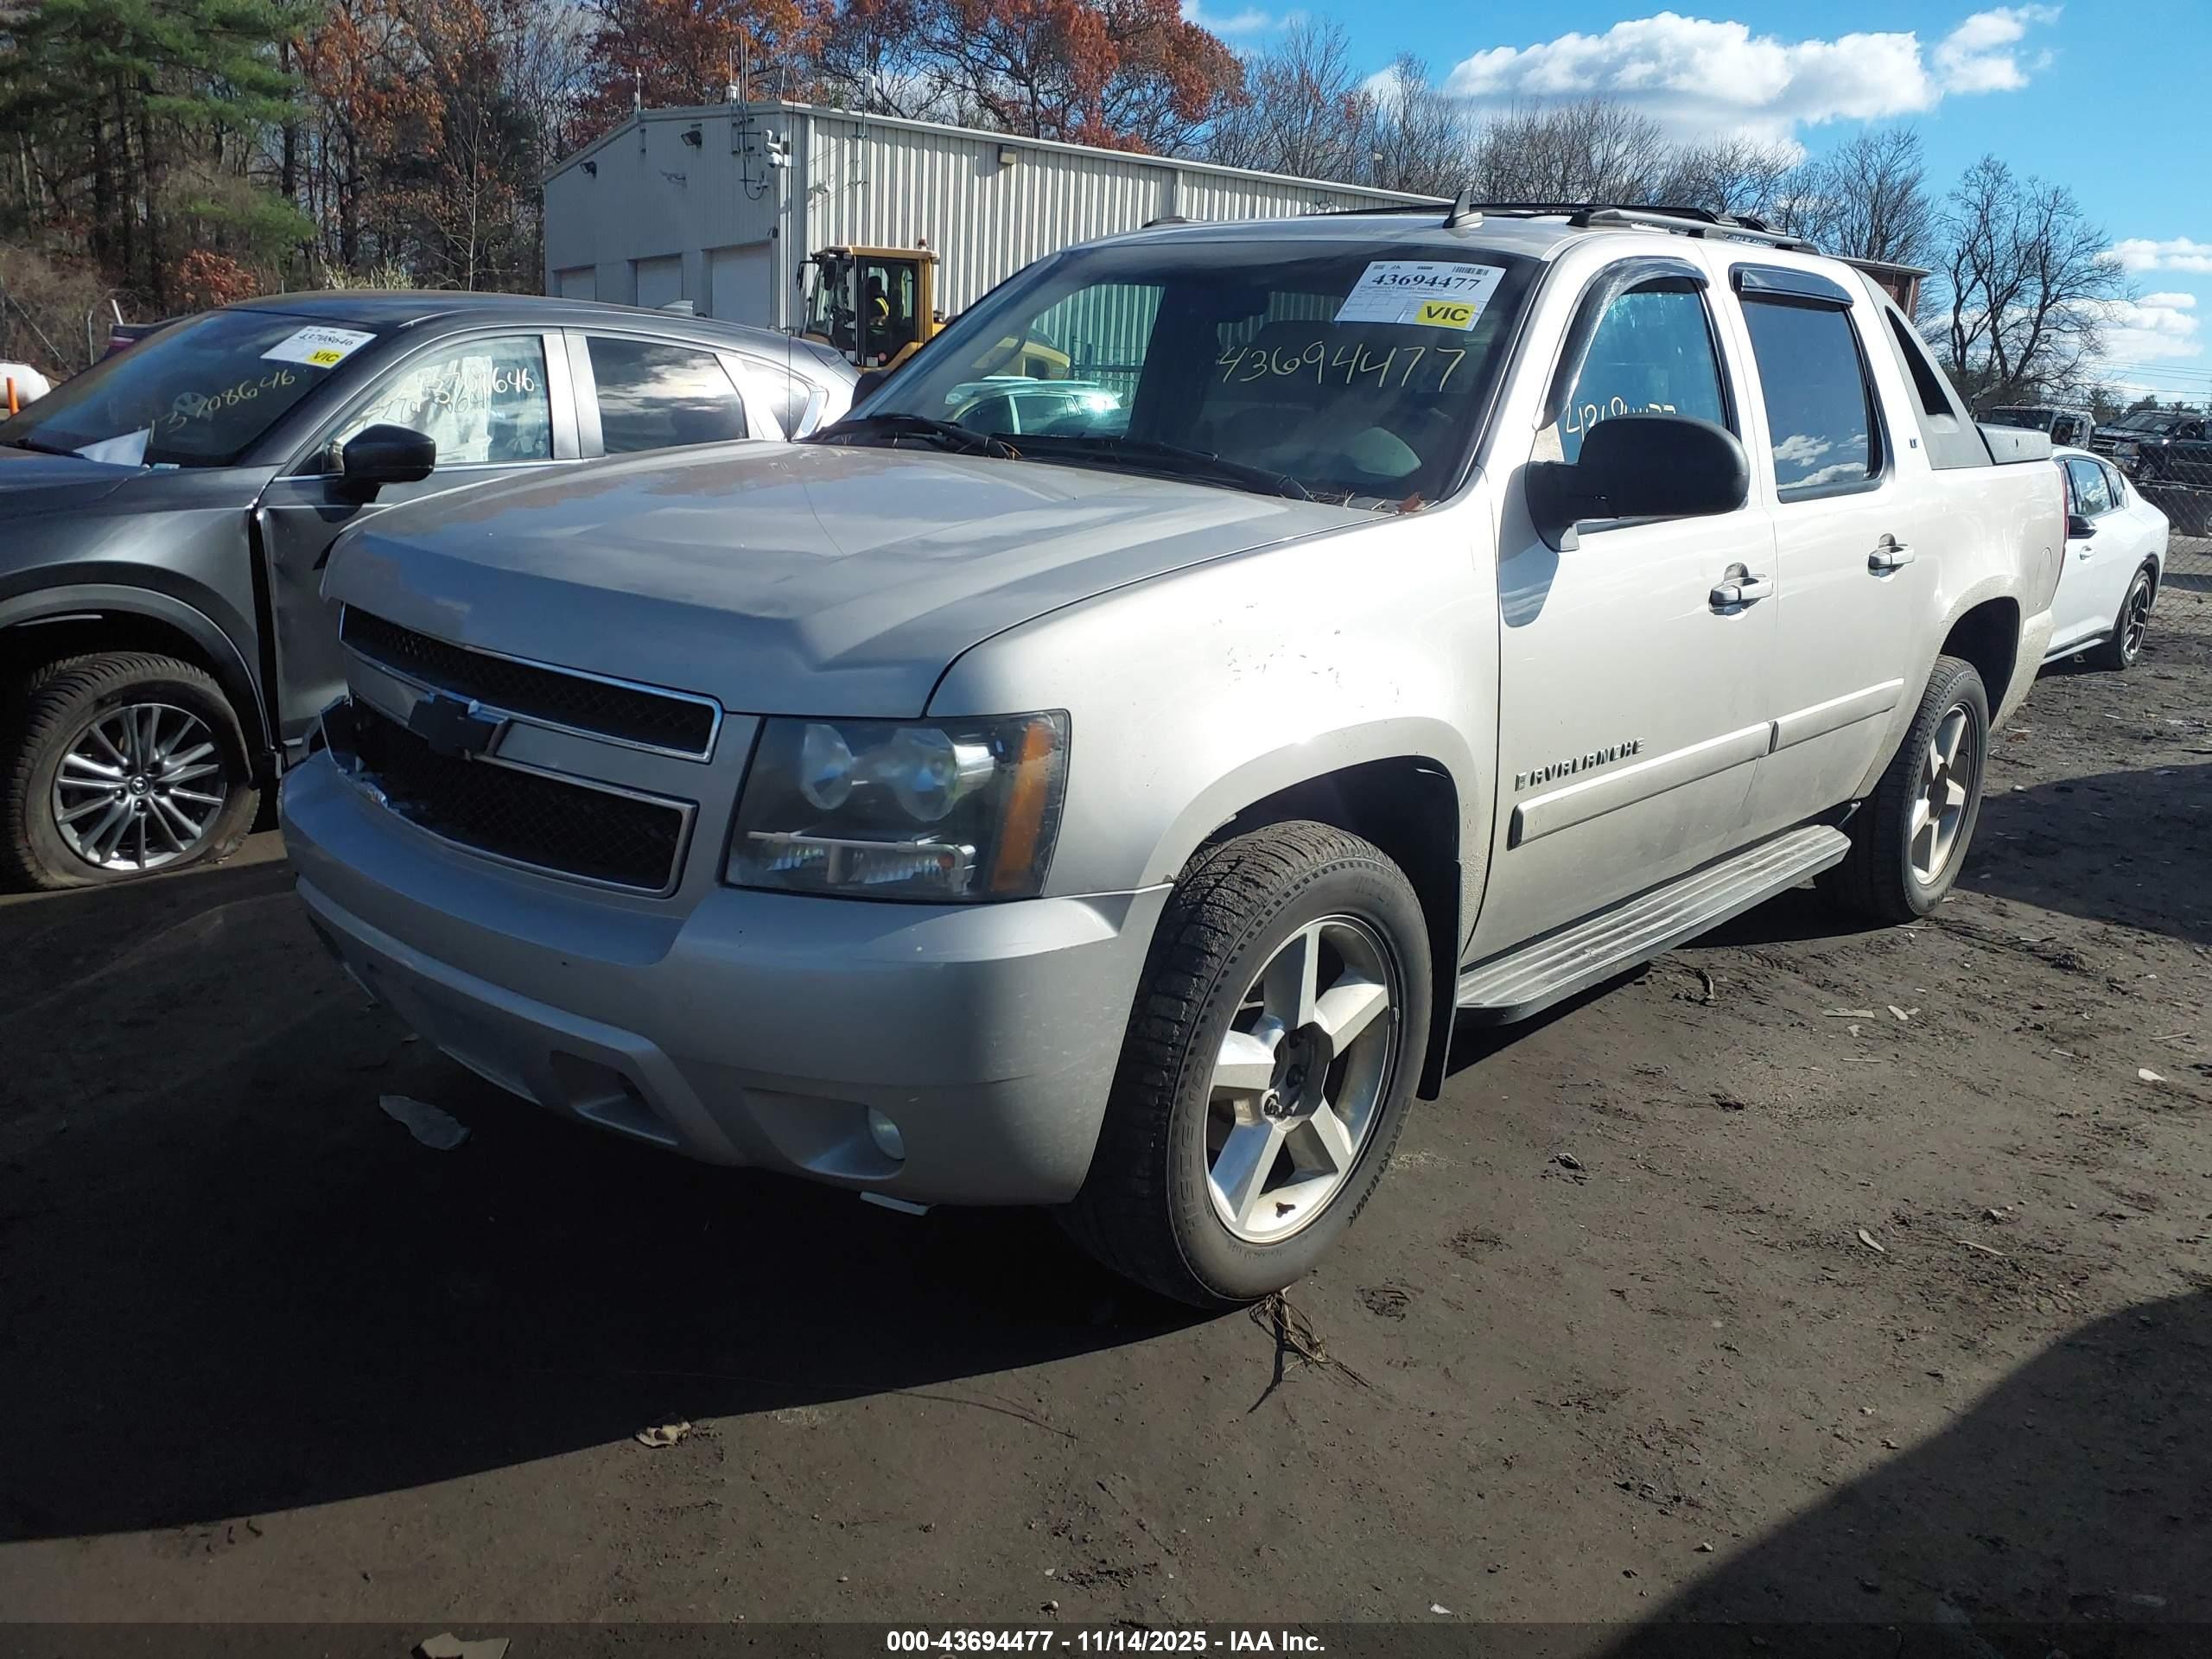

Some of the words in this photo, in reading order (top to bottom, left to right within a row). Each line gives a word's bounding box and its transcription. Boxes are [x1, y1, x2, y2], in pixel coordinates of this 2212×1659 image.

[1371, 273, 1481, 291] 43694477
[1426, 305, 1470, 321] VIC
[314, 351, 340, 362] VIC
[1217, 340, 1466, 392] 43694477
[1529, 738, 1644, 786] AVALANCHE
